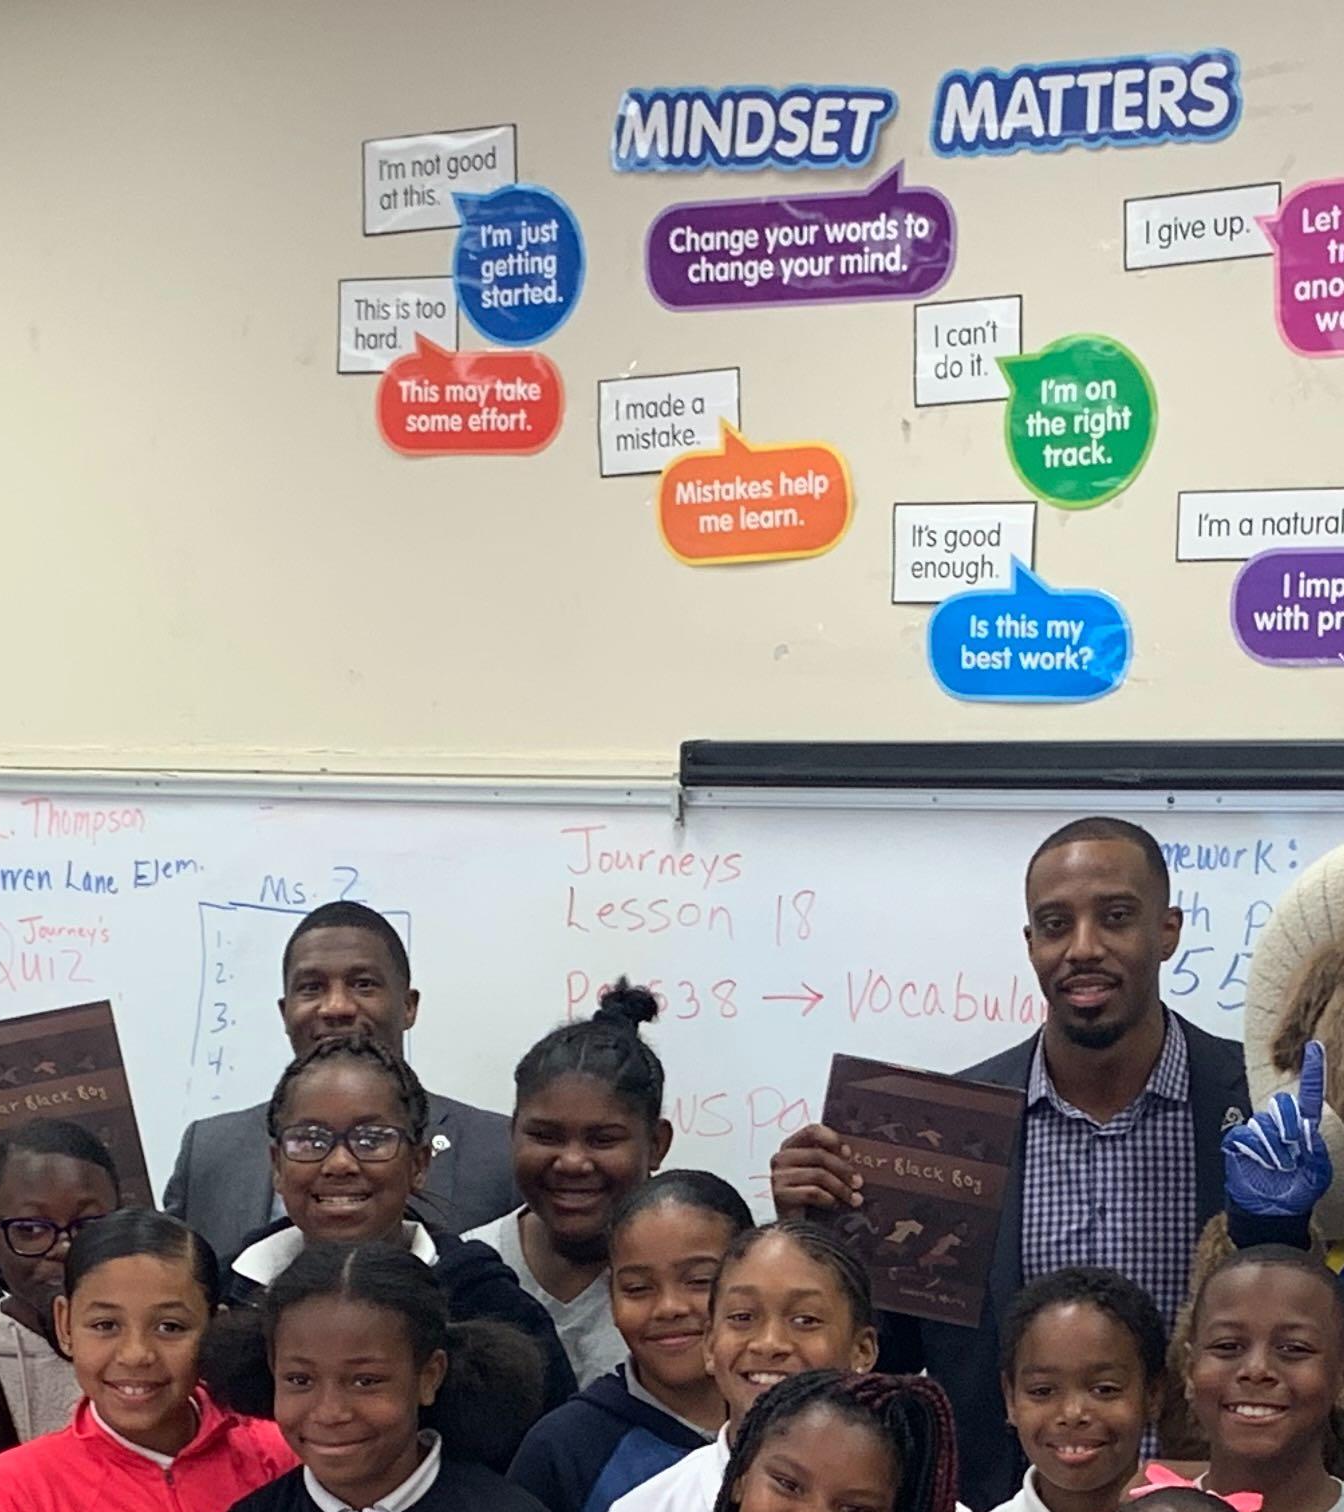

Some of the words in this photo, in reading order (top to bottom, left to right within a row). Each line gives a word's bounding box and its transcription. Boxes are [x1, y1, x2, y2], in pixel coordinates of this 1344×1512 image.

[618, 96, 885, 159] MINDSET
[939, 61, 1230, 144] MATTERS
[379, 157, 406, 180] I'm
[411, 155, 441, 176] not
[447, 149, 496, 177] good
[380, 185, 398, 209] at
[403, 184, 441, 208] this.
[1144, 219, 1151, 244] I
[1158, 217, 1206, 249] give
[1213, 216, 1251, 242] up.
[1301, 205, 1343, 234] Let
[480, 225, 512, 246] I'm
[516, 219, 559, 250] just
[670, 228, 759, 257] Change
[765, 226, 818, 254] your
[825, 216, 899, 244] words
[904, 214, 930, 239] to
[481, 252, 557, 281] getting
[688, 257, 774, 285] change
[780, 256, 833, 283] your
[840, 240, 908, 274] mind.
[355, 298, 390, 321] This
[395, 300, 411, 320] is
[414, 298, 447, 319] too
[481, 283, 564, 308] started.
[355, 326, 403, 351] hard.
[934, 324, 939, 348] I
[944, 320, 999, 346] can't
[934, 353, 963, 379] do
[969, 352, 989, 378] it.
[398, 380, 440, 403] This
[445, 383, 489, 409] may
[495, 378, 541, 401] take
[1041, 379, 1077, 403] I'm
[1086, 378, 1117, 400] on
[405, 411, 461, 434] some
[468, 408, 533, 433] effort.
[615, 399, 621, 421] I
[625, 396, 685, 419] made
[691, 398, 705, 415] a
[616, 425, 702, 451] mistake.
[1026, 411, 1066, 437] the
[1073, 405, 1132, 443] right
[1042, 442, 1113, 468] track.
[675, 478, 773, 506] Mistakes
[779, 472, 829, 502] help
[699, 512, 734, 533] me
[740, 505, 804, 530] learn.
[1197, 513, 1230, 537] I'm
[1240, 520, 1253, 536] a
[911, 524, 938, 548] It's
[944, 522, 1001, 553] good
[910, 555, 1000, 586] enough.
[1283, 573, 1290, 598] I
[970, 615, 989, 638] Is
[996, 612, 1039, 637] this
[1046, 618, 1085, 645] my
[1254, 605, 1309, 632] with
[961, 644, 1012, 671] best
[1019, 646, 1093, 672] work?
[22, 797, 146, 848] Thompson
[561, 824, 743, 888] Journeys
[66, 861, 119, 895] Lane
[133, 856, 204, 889] Elem.
[260, 875, 317, 904] Ms.
[565, 885, 735, 940] Lesson
[775, 889, 816, 946] 18
[215, 962, 234, 984] 2.
[210, 1002, 237, 1034] 3.
[208, 1048, 233, 1075] 4.
[25, 1091, 73, 1111] Black
[77, 1085, 108, 1100] Boy
[851, 1152, 888, 1169] ear
[894, 1156, 944, 1182] Black
[952, 1170, 983, 1194] Boy
